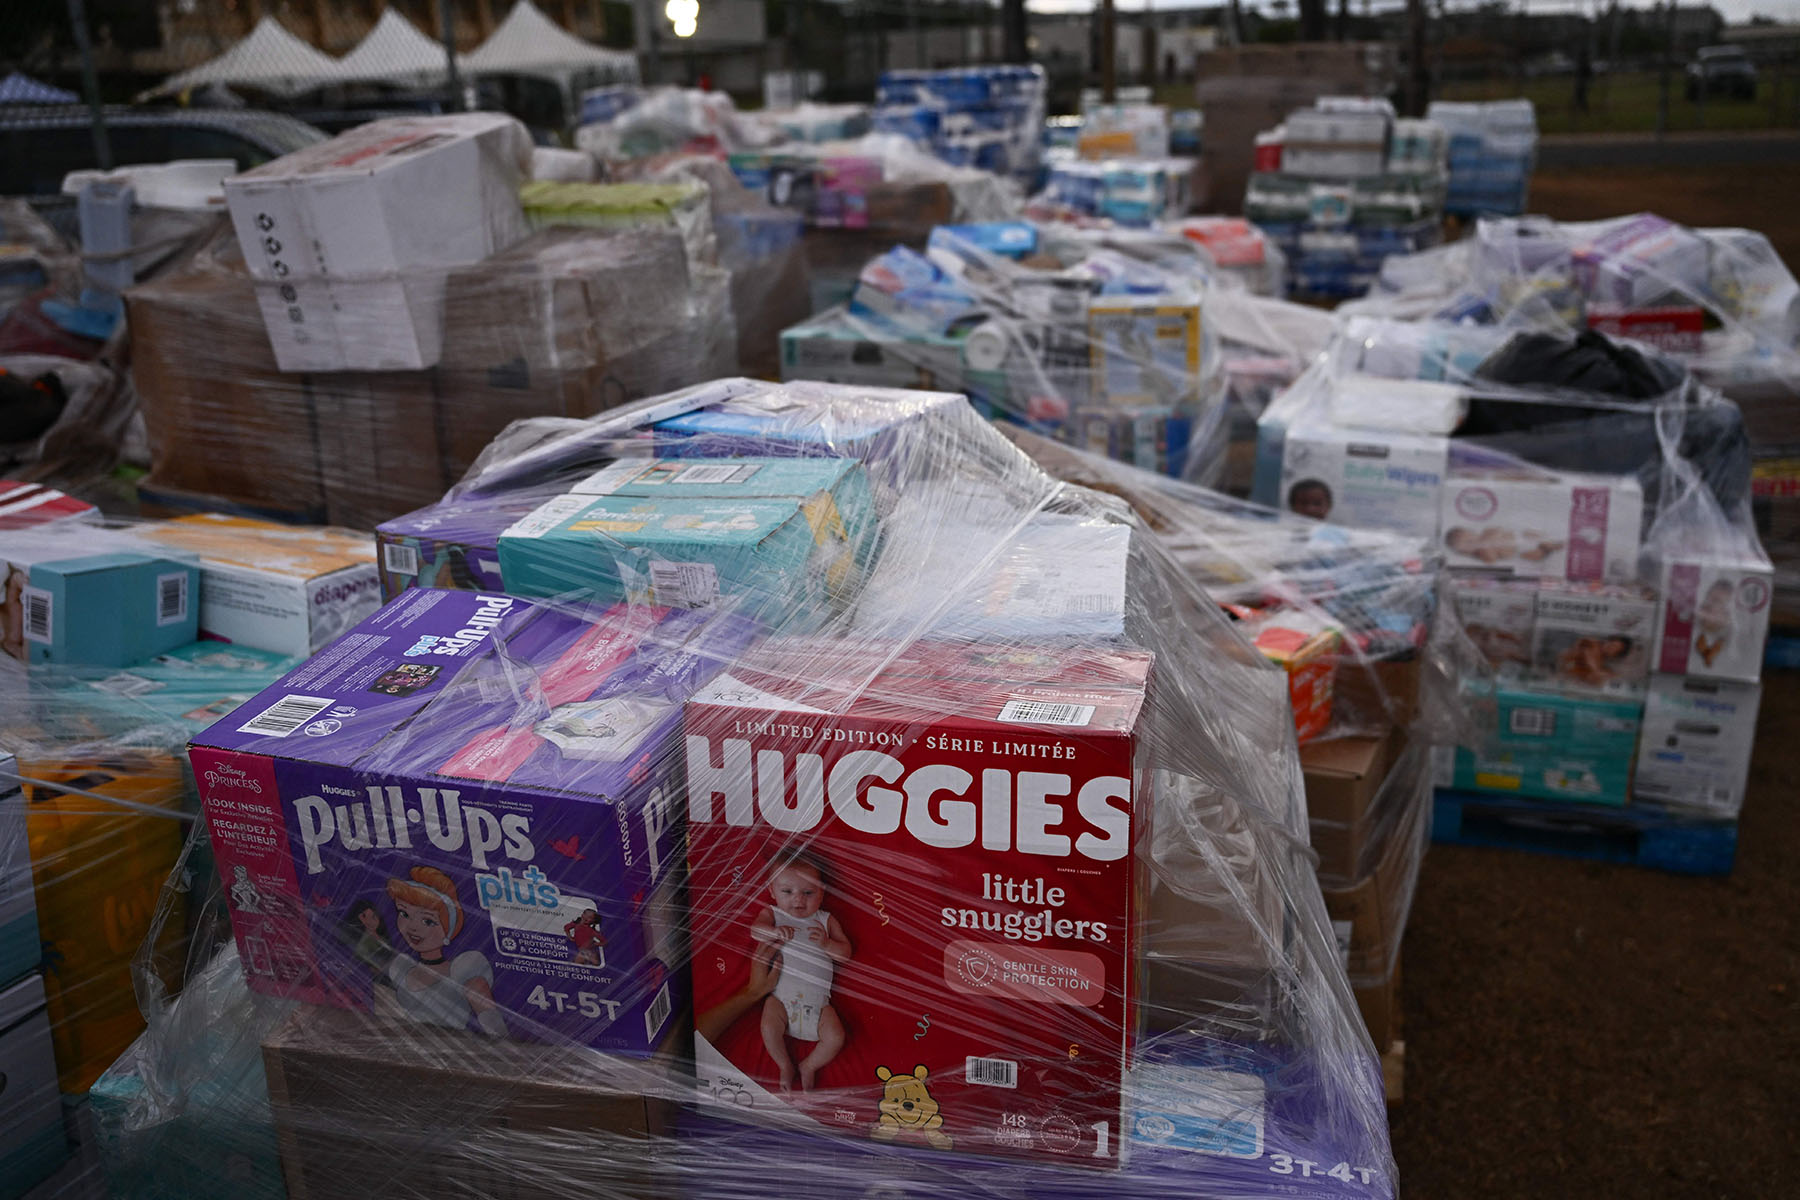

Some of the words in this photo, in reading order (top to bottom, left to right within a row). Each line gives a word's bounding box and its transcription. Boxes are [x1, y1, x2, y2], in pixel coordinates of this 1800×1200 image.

[734, 720, 815, 739] LIMITED
[822, 724, 904, 747] EDITION
[926, 733, 984, 754] SÉRIE
[992, 740, 1077, 760] LIMITÉE
[214, 761, 247, 778] Disney
[204, 770, 262, 794] PRINCESS
[321, 783, 357, 798] HUGGIES
[207, 797, 236, 811] LOOK
[237, 801, 273, 816] INSIDE
[686, 735, 1131, 862] HUGGIES
[212, 818, 267, 836] REGARDEZ
[268, 825, 278, 837] À
[216, 829, 278, 847] L'INTÉRIEUR
[981, 872, 1066, 907] little
[941, 906, 1108, 942] snugglers
[511, 931, 521, 939] TO
[522, 932, 531, 940] 12
[531, 933, 556, 944] HOURS
[556, 936, 567, 944] OF
[518, 938, 569, 953] PROTECTION
[519, 946, 527, 954] &
[528, 946, 569, 960] COMFORT
[495, 961, 544, 976] PROTECTION
[545, 969, 556, 978] ET
[557, 970, 570, 979] DE
[570, 972, 613, 985] CONFORT
[543, 962, 552, 970] 12
[552, 963, 581, 975] HEURES
[581, 968, 592, 976] DE
[1003, 960, 1047, 974] GENTLE
[1050, 964, 1078, 977] SKIN
[1003, 971, 1090, 991] PROTECTION
[526, 984, 622, 1022] 4T-5T
[717, 1076, 744, 1089] Disney
[1001, 1112, 1026, 1128] 148
[1090, 1120, 1112, 1158] 1
[1269, 1153, 1378, 1185] 3T-4T
